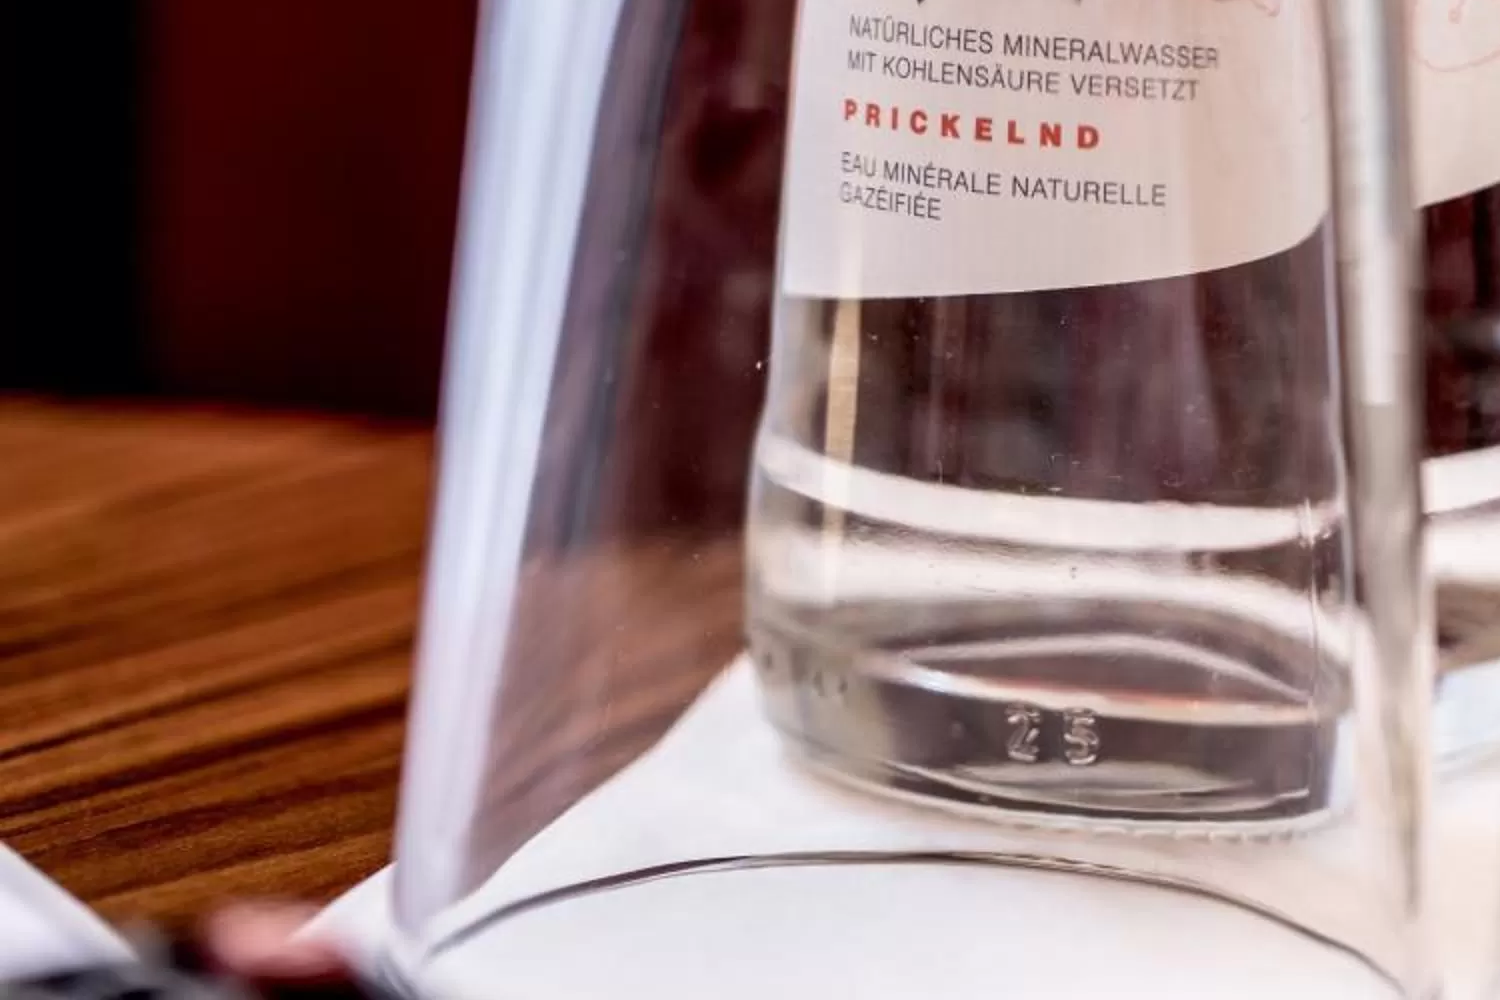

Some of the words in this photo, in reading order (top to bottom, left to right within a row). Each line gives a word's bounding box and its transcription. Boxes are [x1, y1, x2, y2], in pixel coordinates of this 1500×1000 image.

[849, 14, 993, 55] NATÜRLICHES
[1003, 33, 1218, 70] MINERALWASSER
[848, 50, 875, 73] MIT
[883, 56, 1060, 94] KOHLENSÄURE
[1072, 74, 1200, 101] VERSETZT
[843, 99, 1100, 149] PRICKELND
[840, 181, 942, 220] GAZÉIFIÉE
[841, 152, 878, 177] EAU
[883, 158, 1001, 196] MINÉRALE
[1012, 176, 1167, 207] NATURELLE
